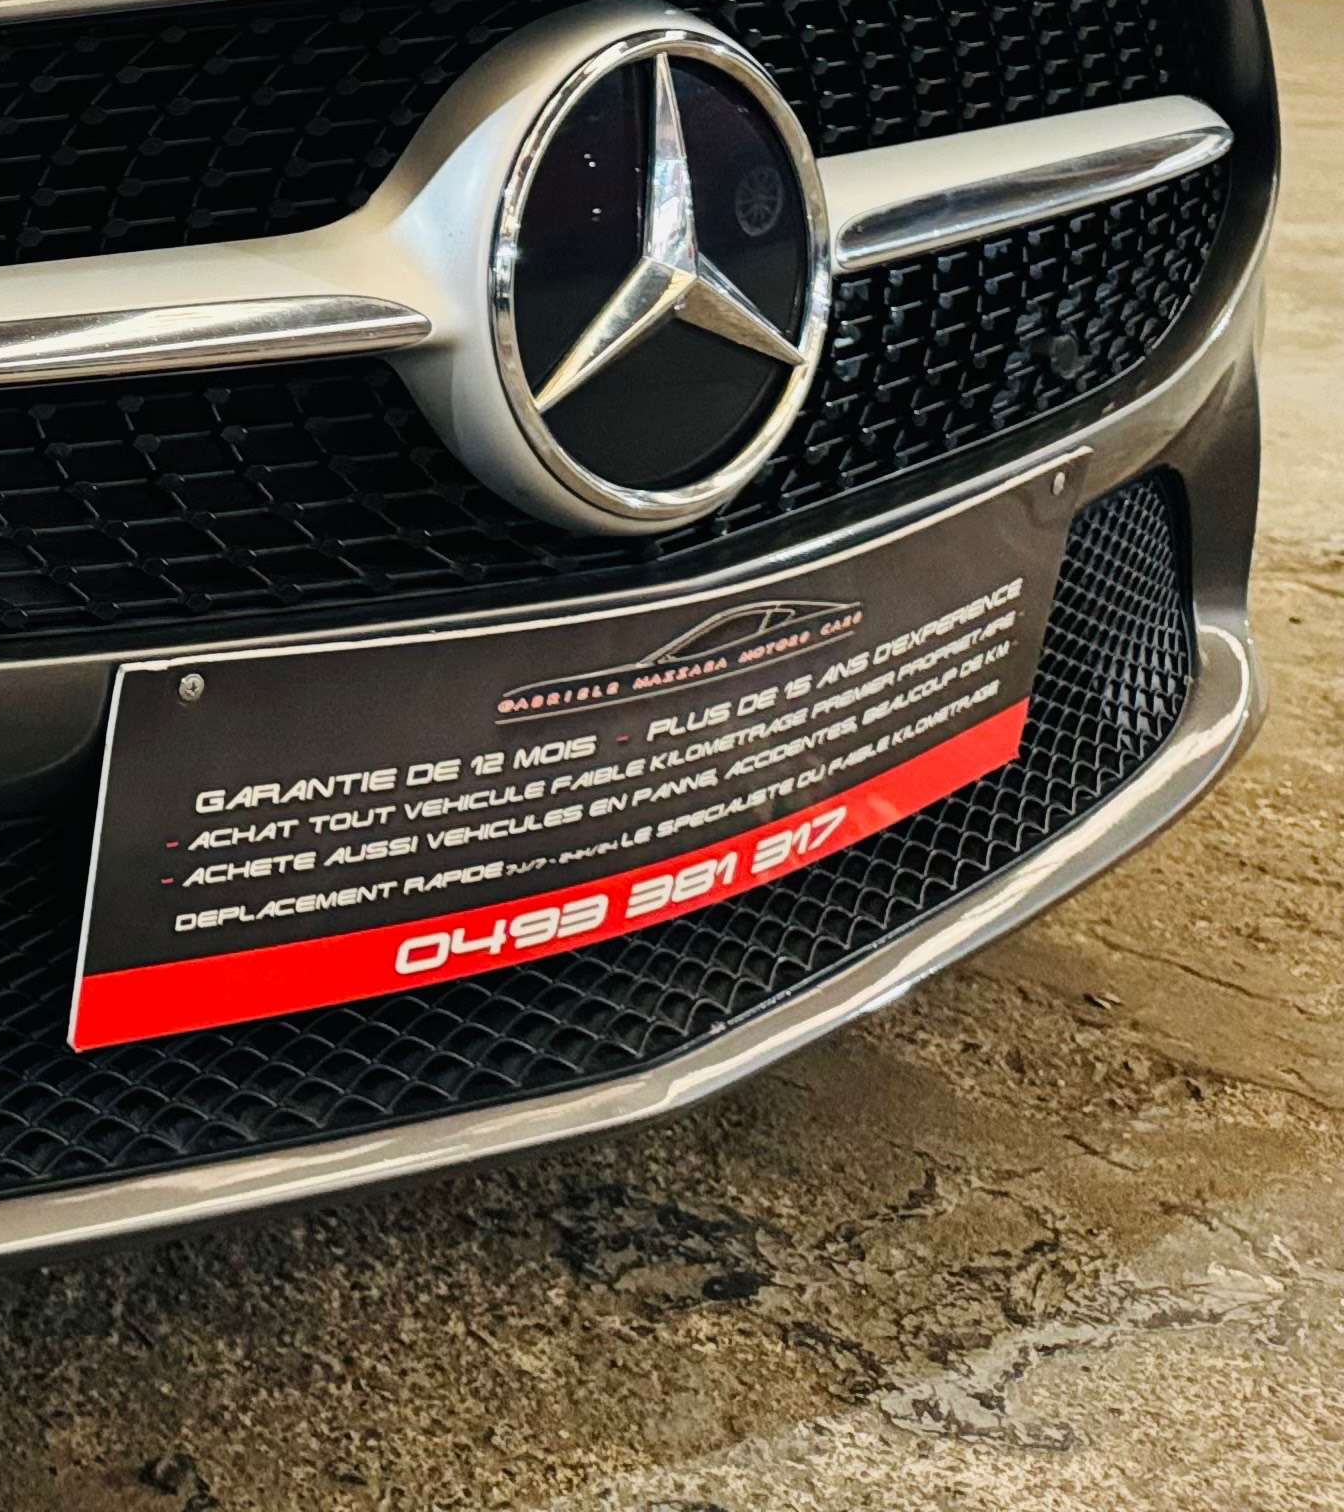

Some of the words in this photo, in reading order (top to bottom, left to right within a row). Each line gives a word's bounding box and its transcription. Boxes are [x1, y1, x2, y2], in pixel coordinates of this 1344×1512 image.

[182, 851, 317, 887] ACHETE
[323, 836, 419, 867] AUSSI
[426, 803, 584, 850] VEHICULES
[588, 793, 629, 817] EN
[862, 666, 959, 726] BEAUCOUP
[959, 652, 985, 678] DE
[984, 639, 1011, 666] KM
[187, 819, 300, 851] ACHAT
[308, 805, 397, 834] TOUT
[403, 779, 546, 821] VEHICULE
[550, 757, 647, 795] FAIBLE
[649, 706, 810, 772] KILOMETRAGE
[811, 669, 896, 720] PREMIER
[195, 767, 398, 814] GARANTIE
[405, 758, 462, 787] DE
[470, 752, 505, 776] 12
[512, 734, 598, 770] MOIS
[646, 700, 733, 742] PLUS
[737, 685, 780, 717] DE
[784, 673, 813, 700] 15
[816, 651, 871, 689] ANS
[174, 881, 398, 932] DEPLACEMENT
[402, 860, 504, 896] RAPIDE
[620, 825, 654, 848] LE
[656, 776, 796, 838] SPECIALISTE
[797, 763, 826, 789] DU
[827, 734, 891, 776] FAIBLE
[393, 893, 609, 975] 0493
[624, 851, 739, 919] 381
[750, 805, 848, 874] 317
